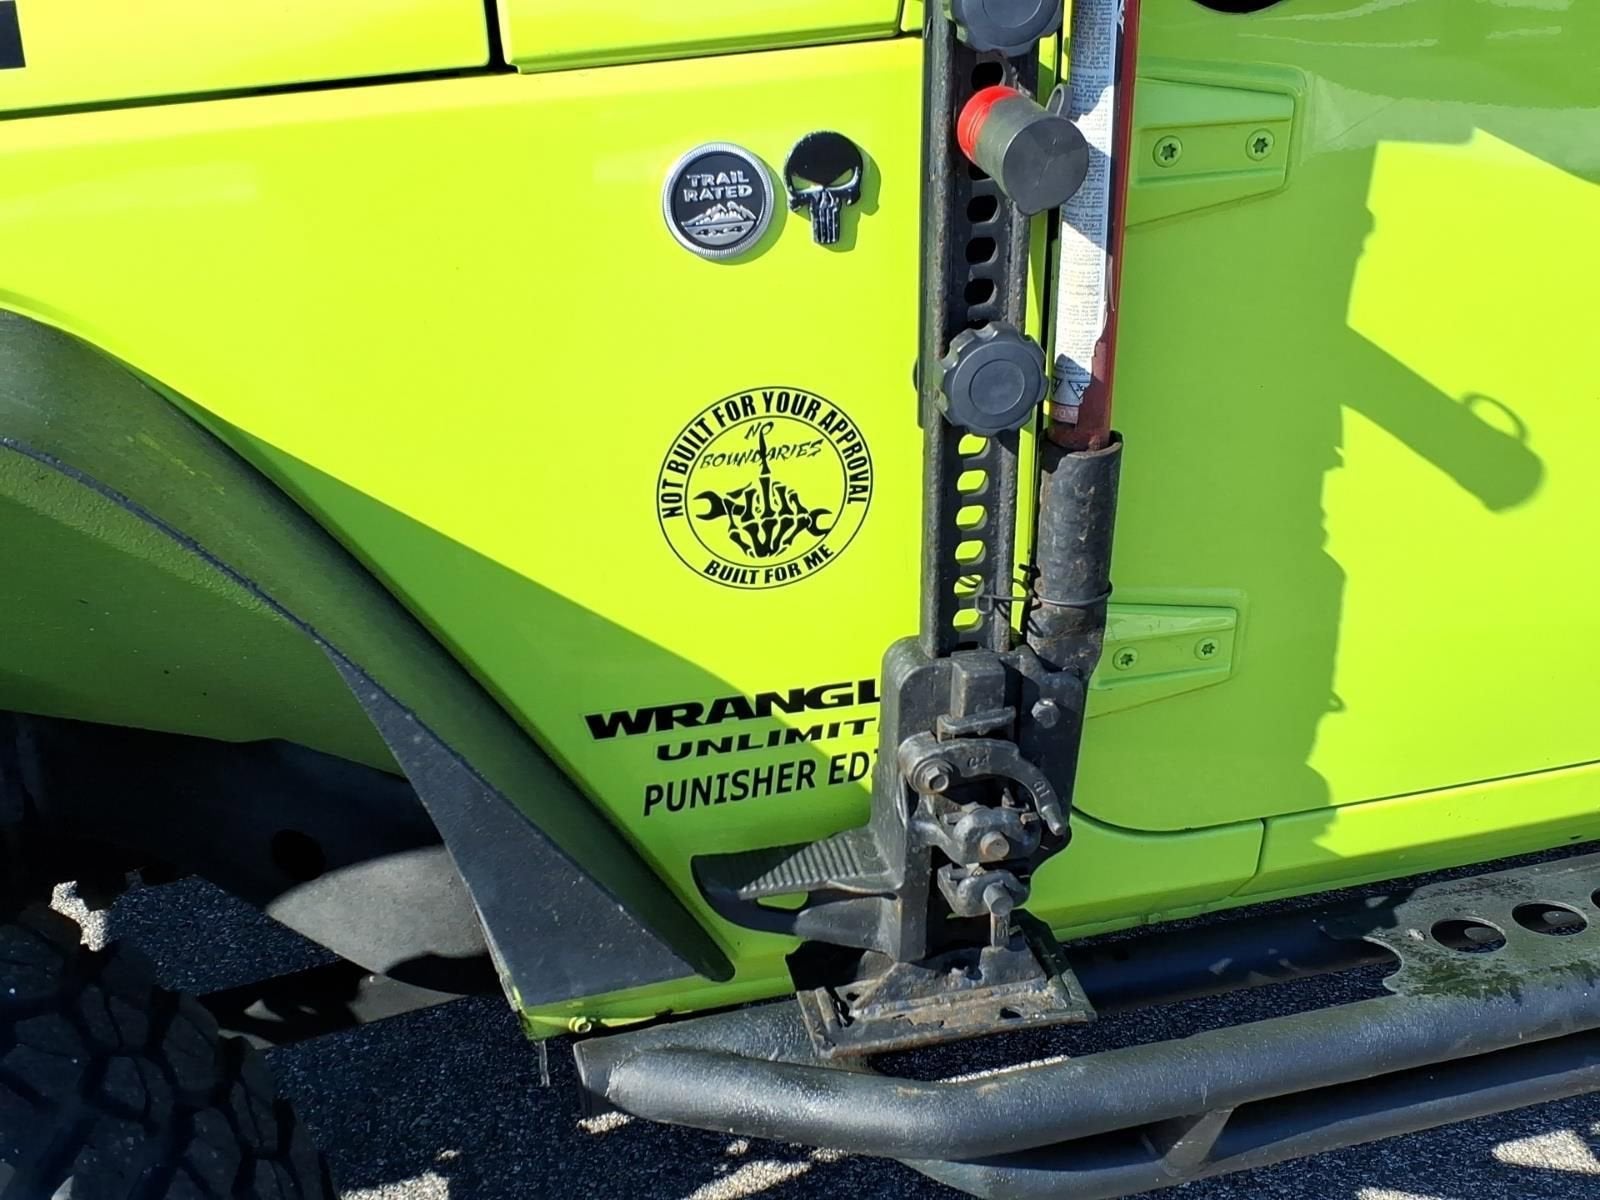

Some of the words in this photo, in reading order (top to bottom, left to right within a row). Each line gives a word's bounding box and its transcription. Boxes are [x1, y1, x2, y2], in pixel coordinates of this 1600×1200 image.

[683, 184, 752, 202] RATED
[687, 170, 749, 187] TRAIL
[713, 394, 756, 428] FOR
[762, 391, 821, 421] YOUR
[666, 418, 714, 475] BUILT
[744, 421, 774, 439] NO
[699, 439, 825, 469] BOUNDARIES
[819, 409, 870, 504] APPROVAL
[660, 479, 684, 519] NOT
[704, 559, 759, 585] BUILT
[764, 563, 802, 584] FOR
[805, 544, 834, 570] ME
[656, 716, 881, 761] UNLIMIT
[644, 759, 817, 816] PUNISHER
[827, 749, 878, 785] ED
